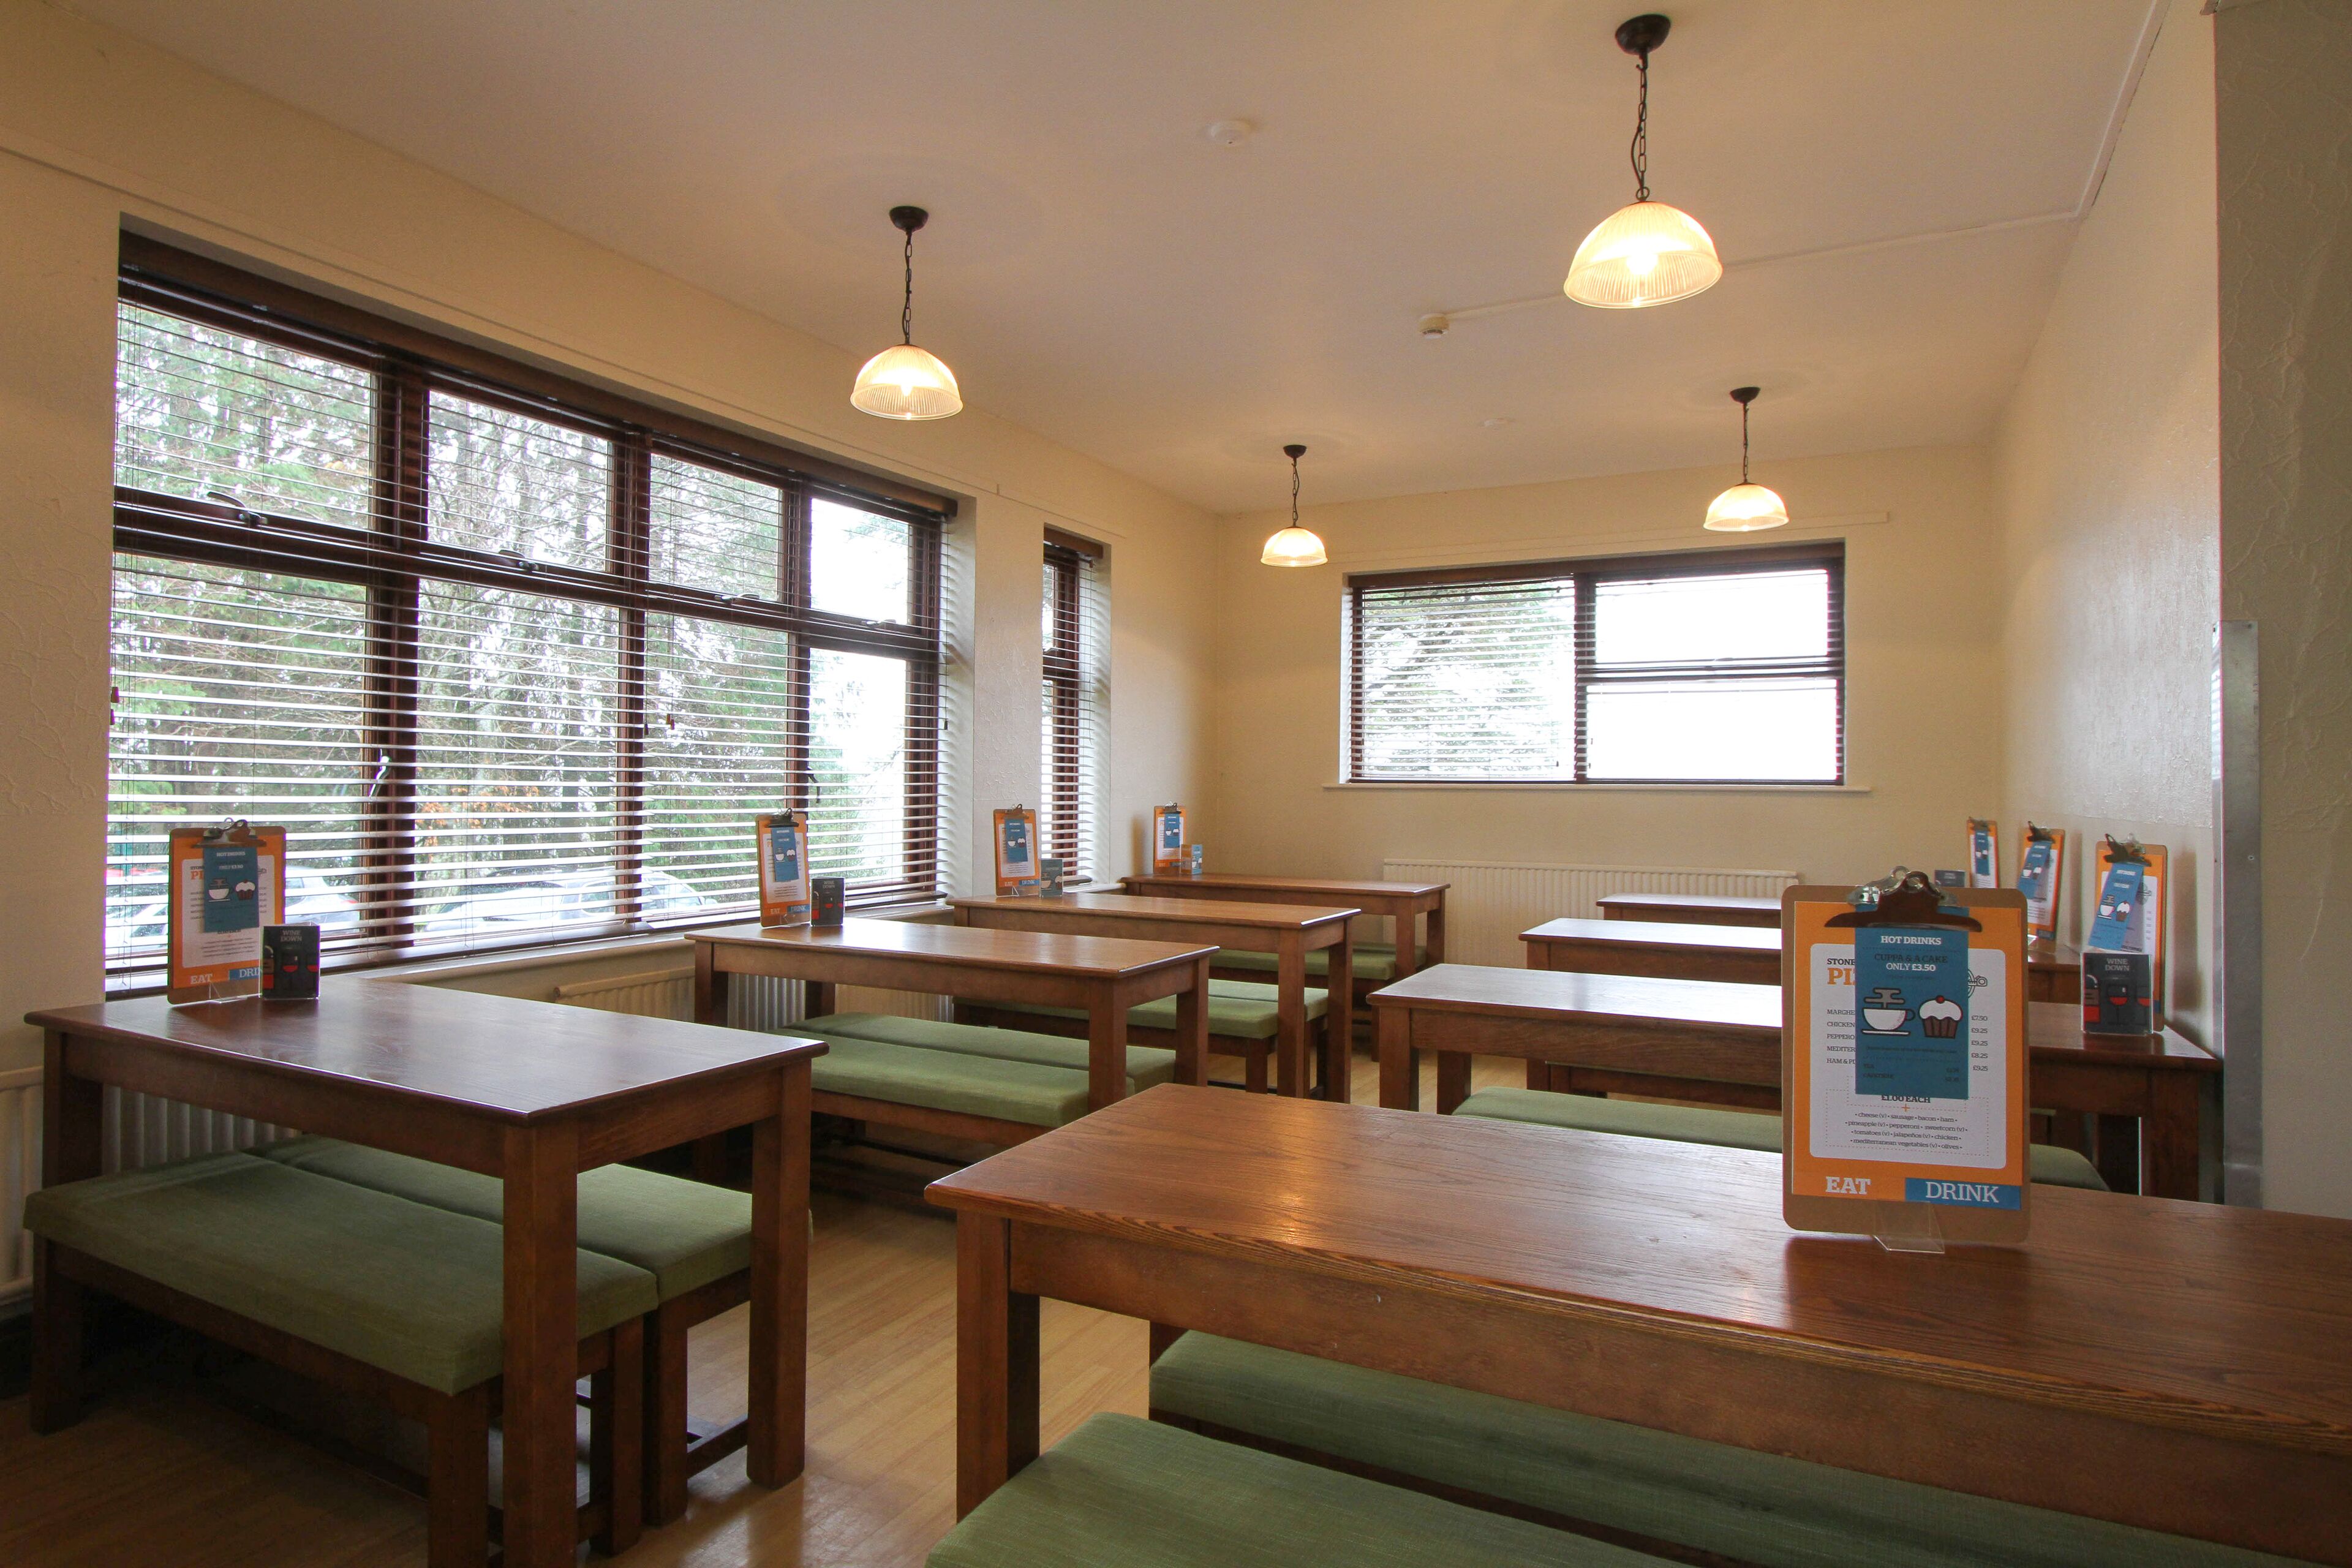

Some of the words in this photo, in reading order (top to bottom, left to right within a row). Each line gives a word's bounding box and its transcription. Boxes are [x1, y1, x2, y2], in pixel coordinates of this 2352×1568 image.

[1881, 936, 1904, 944] HOT
[1904, 936, 1942, 945] DRINKS
[1912, 963, 1936, 971] £3.50
[190, 973, 213, 985] EAT
[1827, 967, 1856, 986] PI
[1825, 1176, 1871, 1195] EAT
[1926, 1181, 1999, 1203] DRINK
